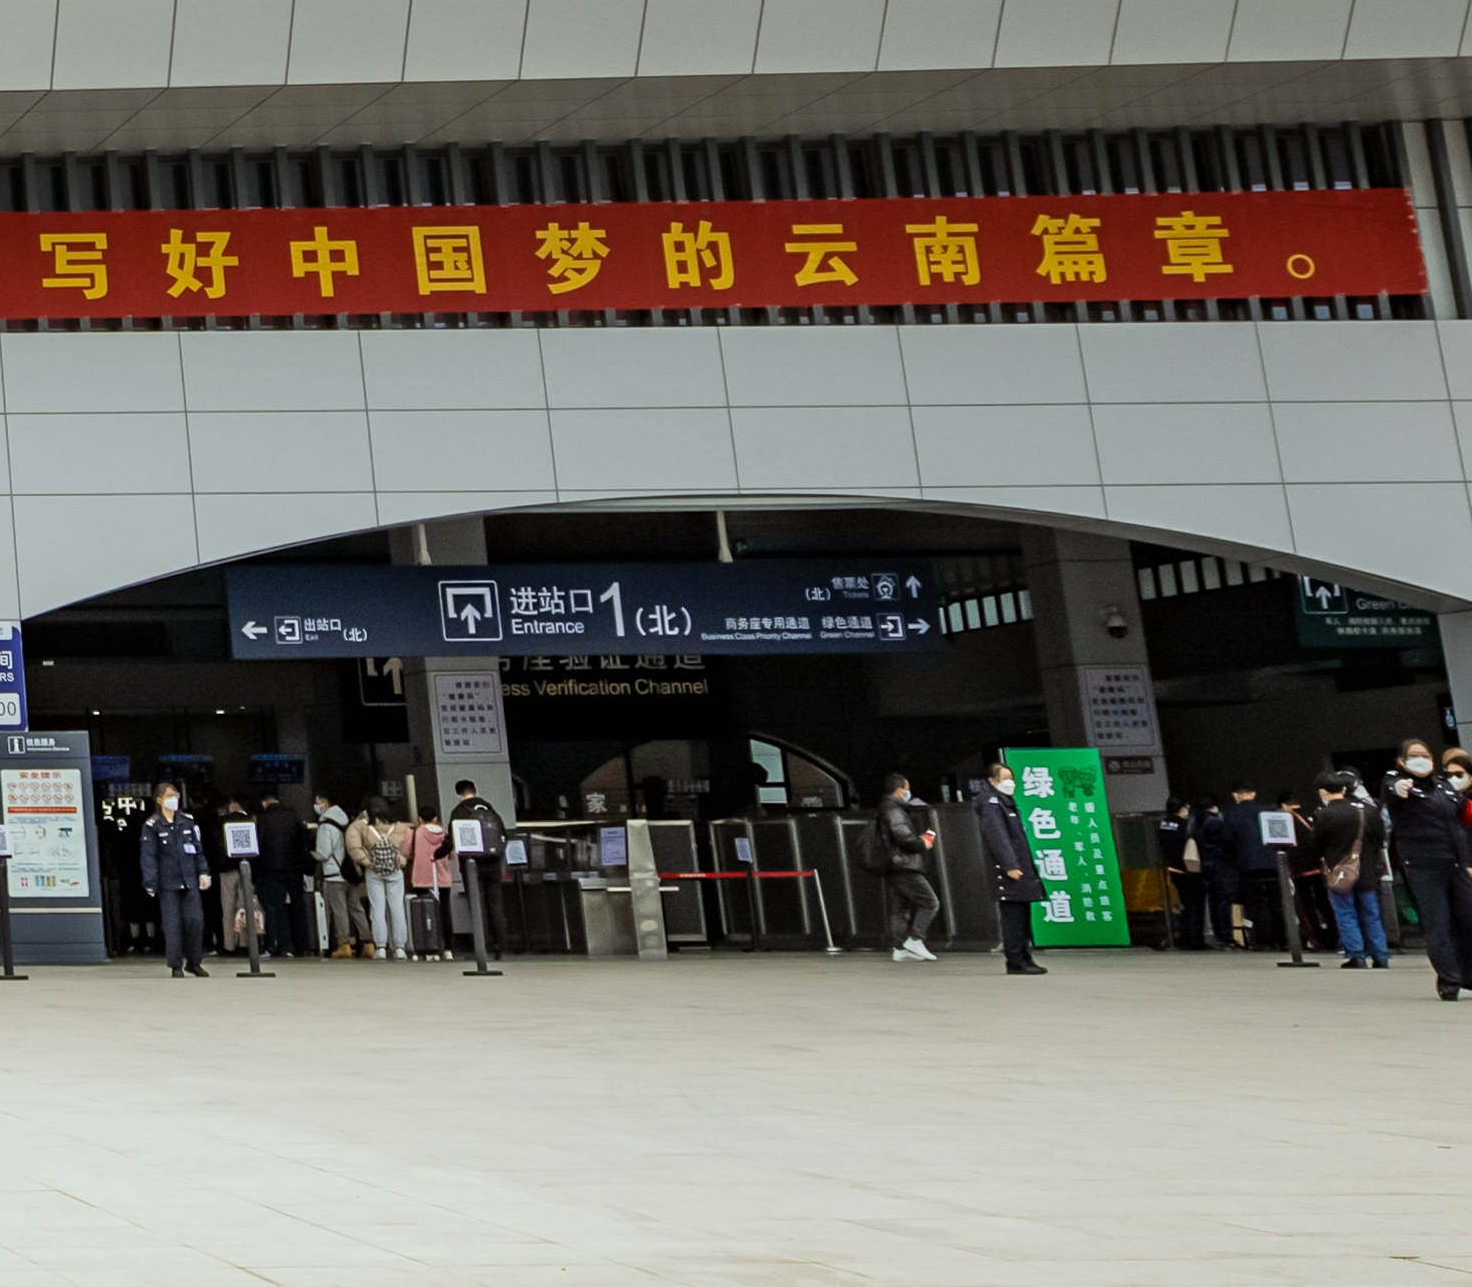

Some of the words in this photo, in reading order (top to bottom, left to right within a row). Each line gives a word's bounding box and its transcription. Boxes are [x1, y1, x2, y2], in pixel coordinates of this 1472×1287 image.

[832, 576, 869, 590] 售票处
[510, 586, 593, 615] 进站口
[843, 590, 869, 599] Tickets
[304, 618, 342, 632] 出站口
[511, 619, 584, 635] Entrance
[725, 617, 810, 630] 商务座专用通道
[822, 617, 873, 630] 绿色通道
[700, 632, 734, 640] Business
[735, 632, 755, 640] Class
[755, 632, 781, 641] Priority
[782, 631, 813, 640] Channel
[820, 631, 844, 639] Green
[845, 630, 876, 639] Channel
[534, 679, 632, 696] Verification
[634, 678, 709, 695] Channel
[26, 737, 55, 746] 信息服务
[1021, 766, 1075, 923] 绿色通道
[1083, 801, 1114, 922] 援人员及重点旅客
